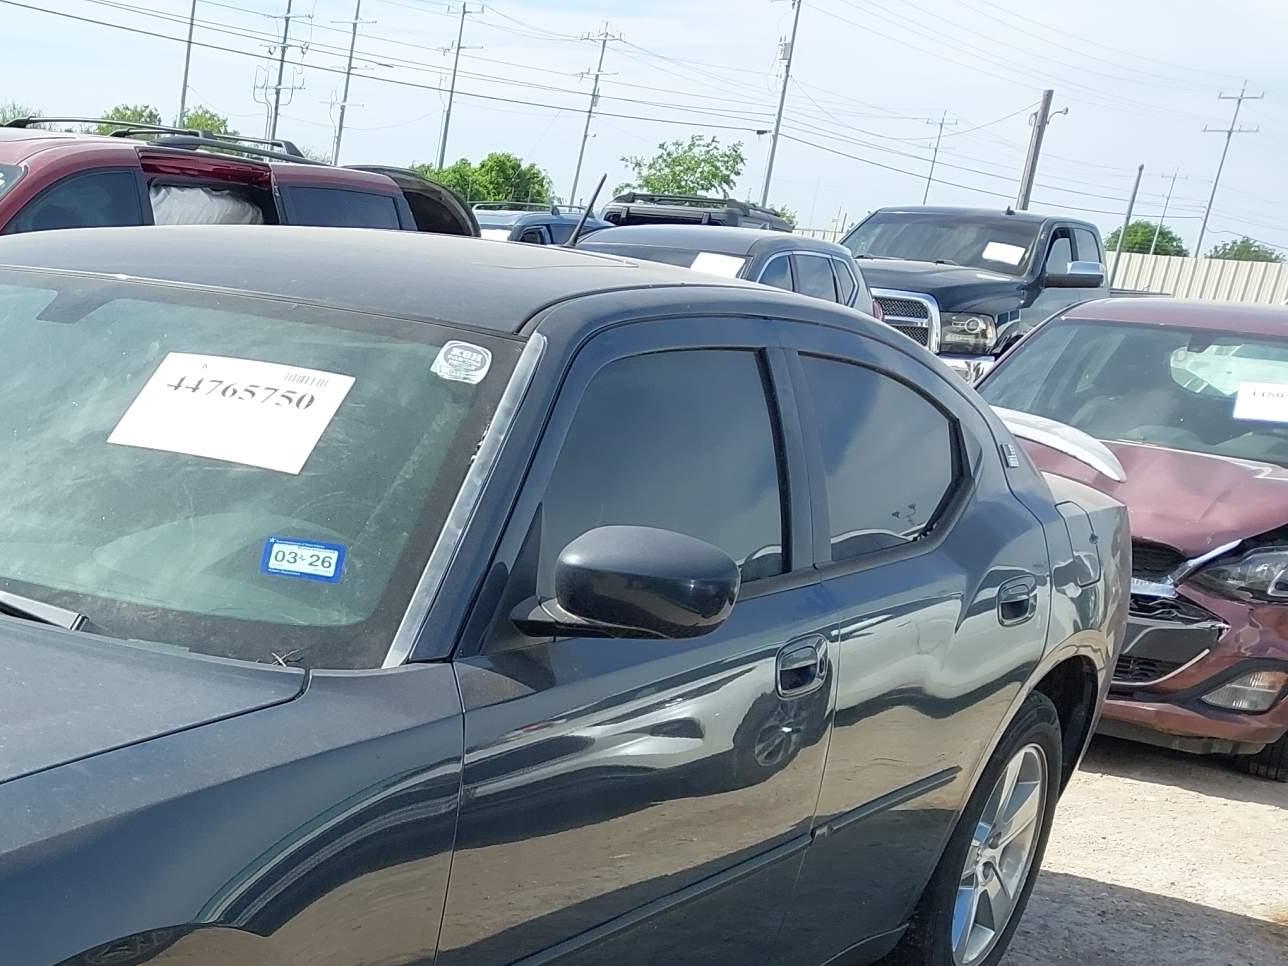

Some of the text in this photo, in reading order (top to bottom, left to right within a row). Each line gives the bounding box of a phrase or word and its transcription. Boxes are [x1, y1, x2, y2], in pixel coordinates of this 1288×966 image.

[166, 375, 316, 411] 44765750
[274, 550, 298, 565] 03
[308, 553, 333, 569] 26
